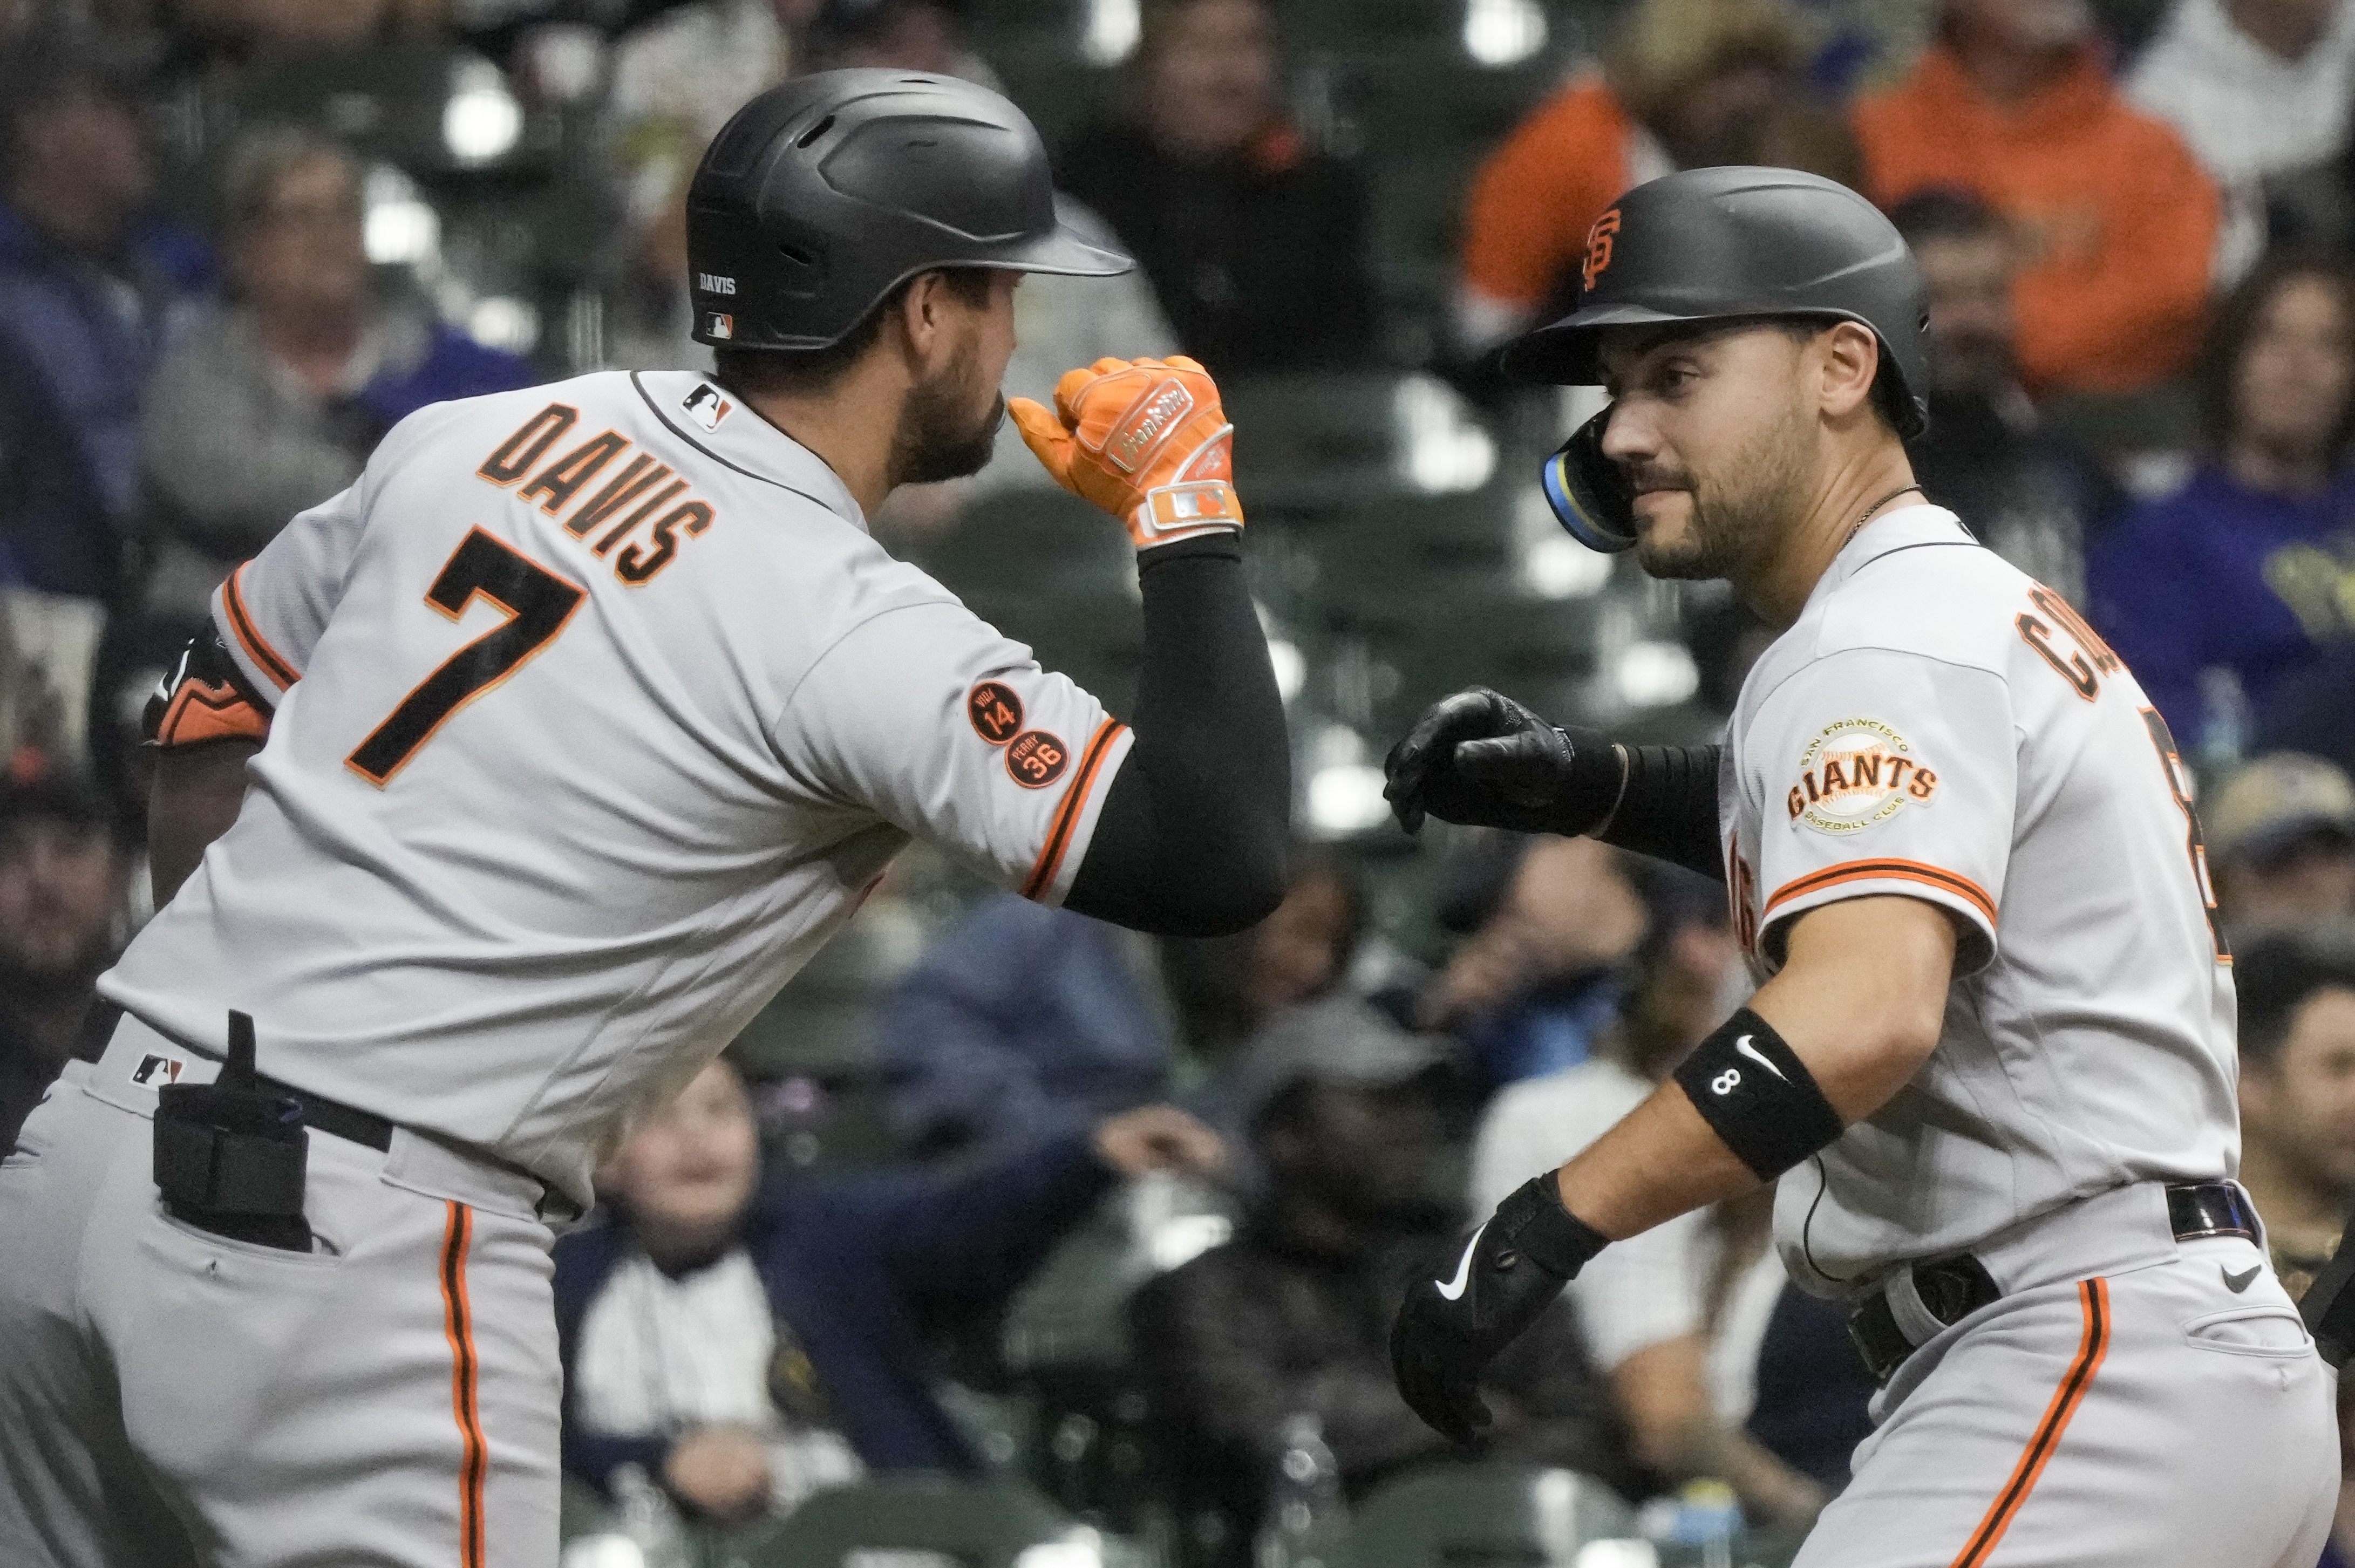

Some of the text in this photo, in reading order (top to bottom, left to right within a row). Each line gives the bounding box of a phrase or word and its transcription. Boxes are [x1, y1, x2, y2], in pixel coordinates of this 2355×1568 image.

[700, 272, 736, 295] DAVIS
[1118, 389, 1186, 462] Franklin
[475, 401, 717, 587] DAVIS
[343, 523, 589, 792] 7
[984, 701, 1016, 735] 14
[1011, 734, 1039, 761] PERRY
[1801, 718, 1909, 767] SAN FRANCISCO
[1023, 743, 1062, 779] 36
[1787, 753, 1939, 822] GIANTS
[1805, 796, 1905, 831] BASEBALL CLUB
[1711, 1068, 1741, 1095] 8
